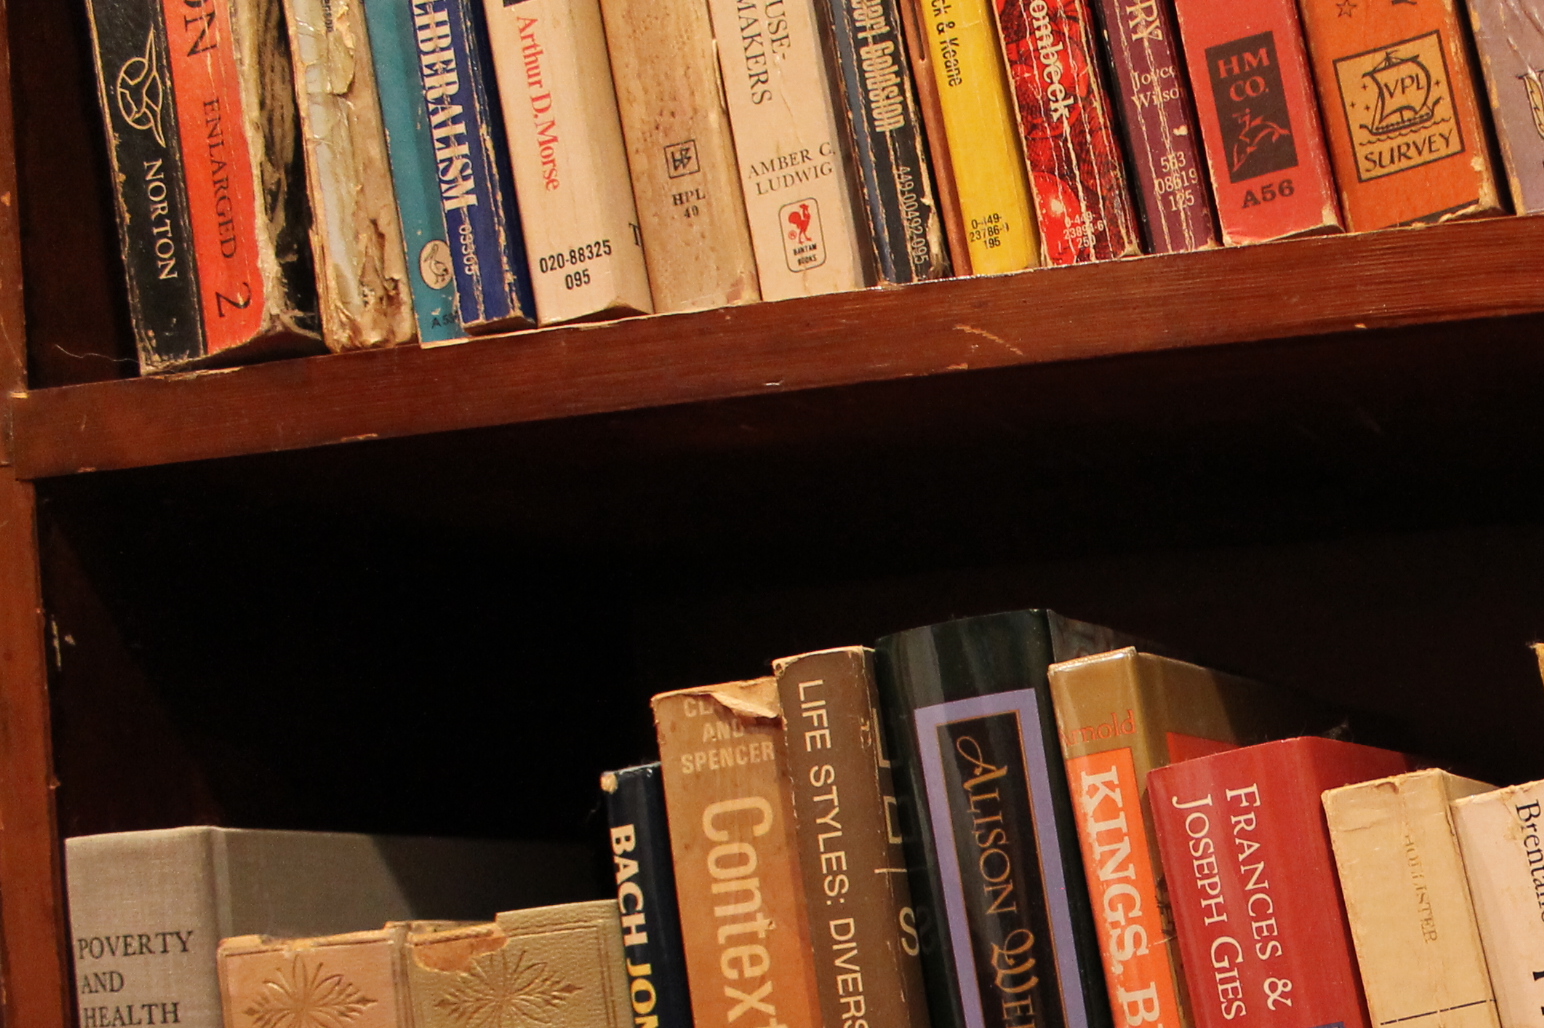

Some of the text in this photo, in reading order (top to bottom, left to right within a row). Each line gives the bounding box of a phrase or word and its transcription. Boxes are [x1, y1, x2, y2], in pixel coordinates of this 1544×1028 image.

[936, 21, 962, 87] & Keane
[516, 16, 561, 191] Arthur D. Morse
[860, 40, 906, 133] Goldston
[1229, 75, 1270, 103] CO.
[1383, 73, 1426, 101] VPL
[748, 148, 813, 179] AMBER
[1160, 151, 1186, 173] 563
[1363, 128, 1454, 173] SURVEY
[203, 97, 238, 260] ENLARGED
[756, 161, 834, 196] LUDWIG
[1156, 168, 1198, 194] 08619
[1241, 178, 1296, 210] A56
[672, 188, 706, 207] HPL
[1168, 189, 1195, 212] 125
[143, 158, 178, 281] NORTON
[539, 239, 613, 275] 020-88325
[565, 268, 592, 291] 095
[216, 282, 252, 319] 2
[798, 678, 833, 753] LIFE
[680, 740, 776, 775] SPENCER
[808, 763, 852, 908] STYLES:
[955, 734, 1020, 917] ALISON
[610, 823, 648, 945] BACH
[1226, 782, 1293, 1011] FRANCES &
[1171, 793, 1248, 1021] JOSEPH GIES
[78, 930, 195, 960] POVERTY
[80, 970, 125, 995] AND
